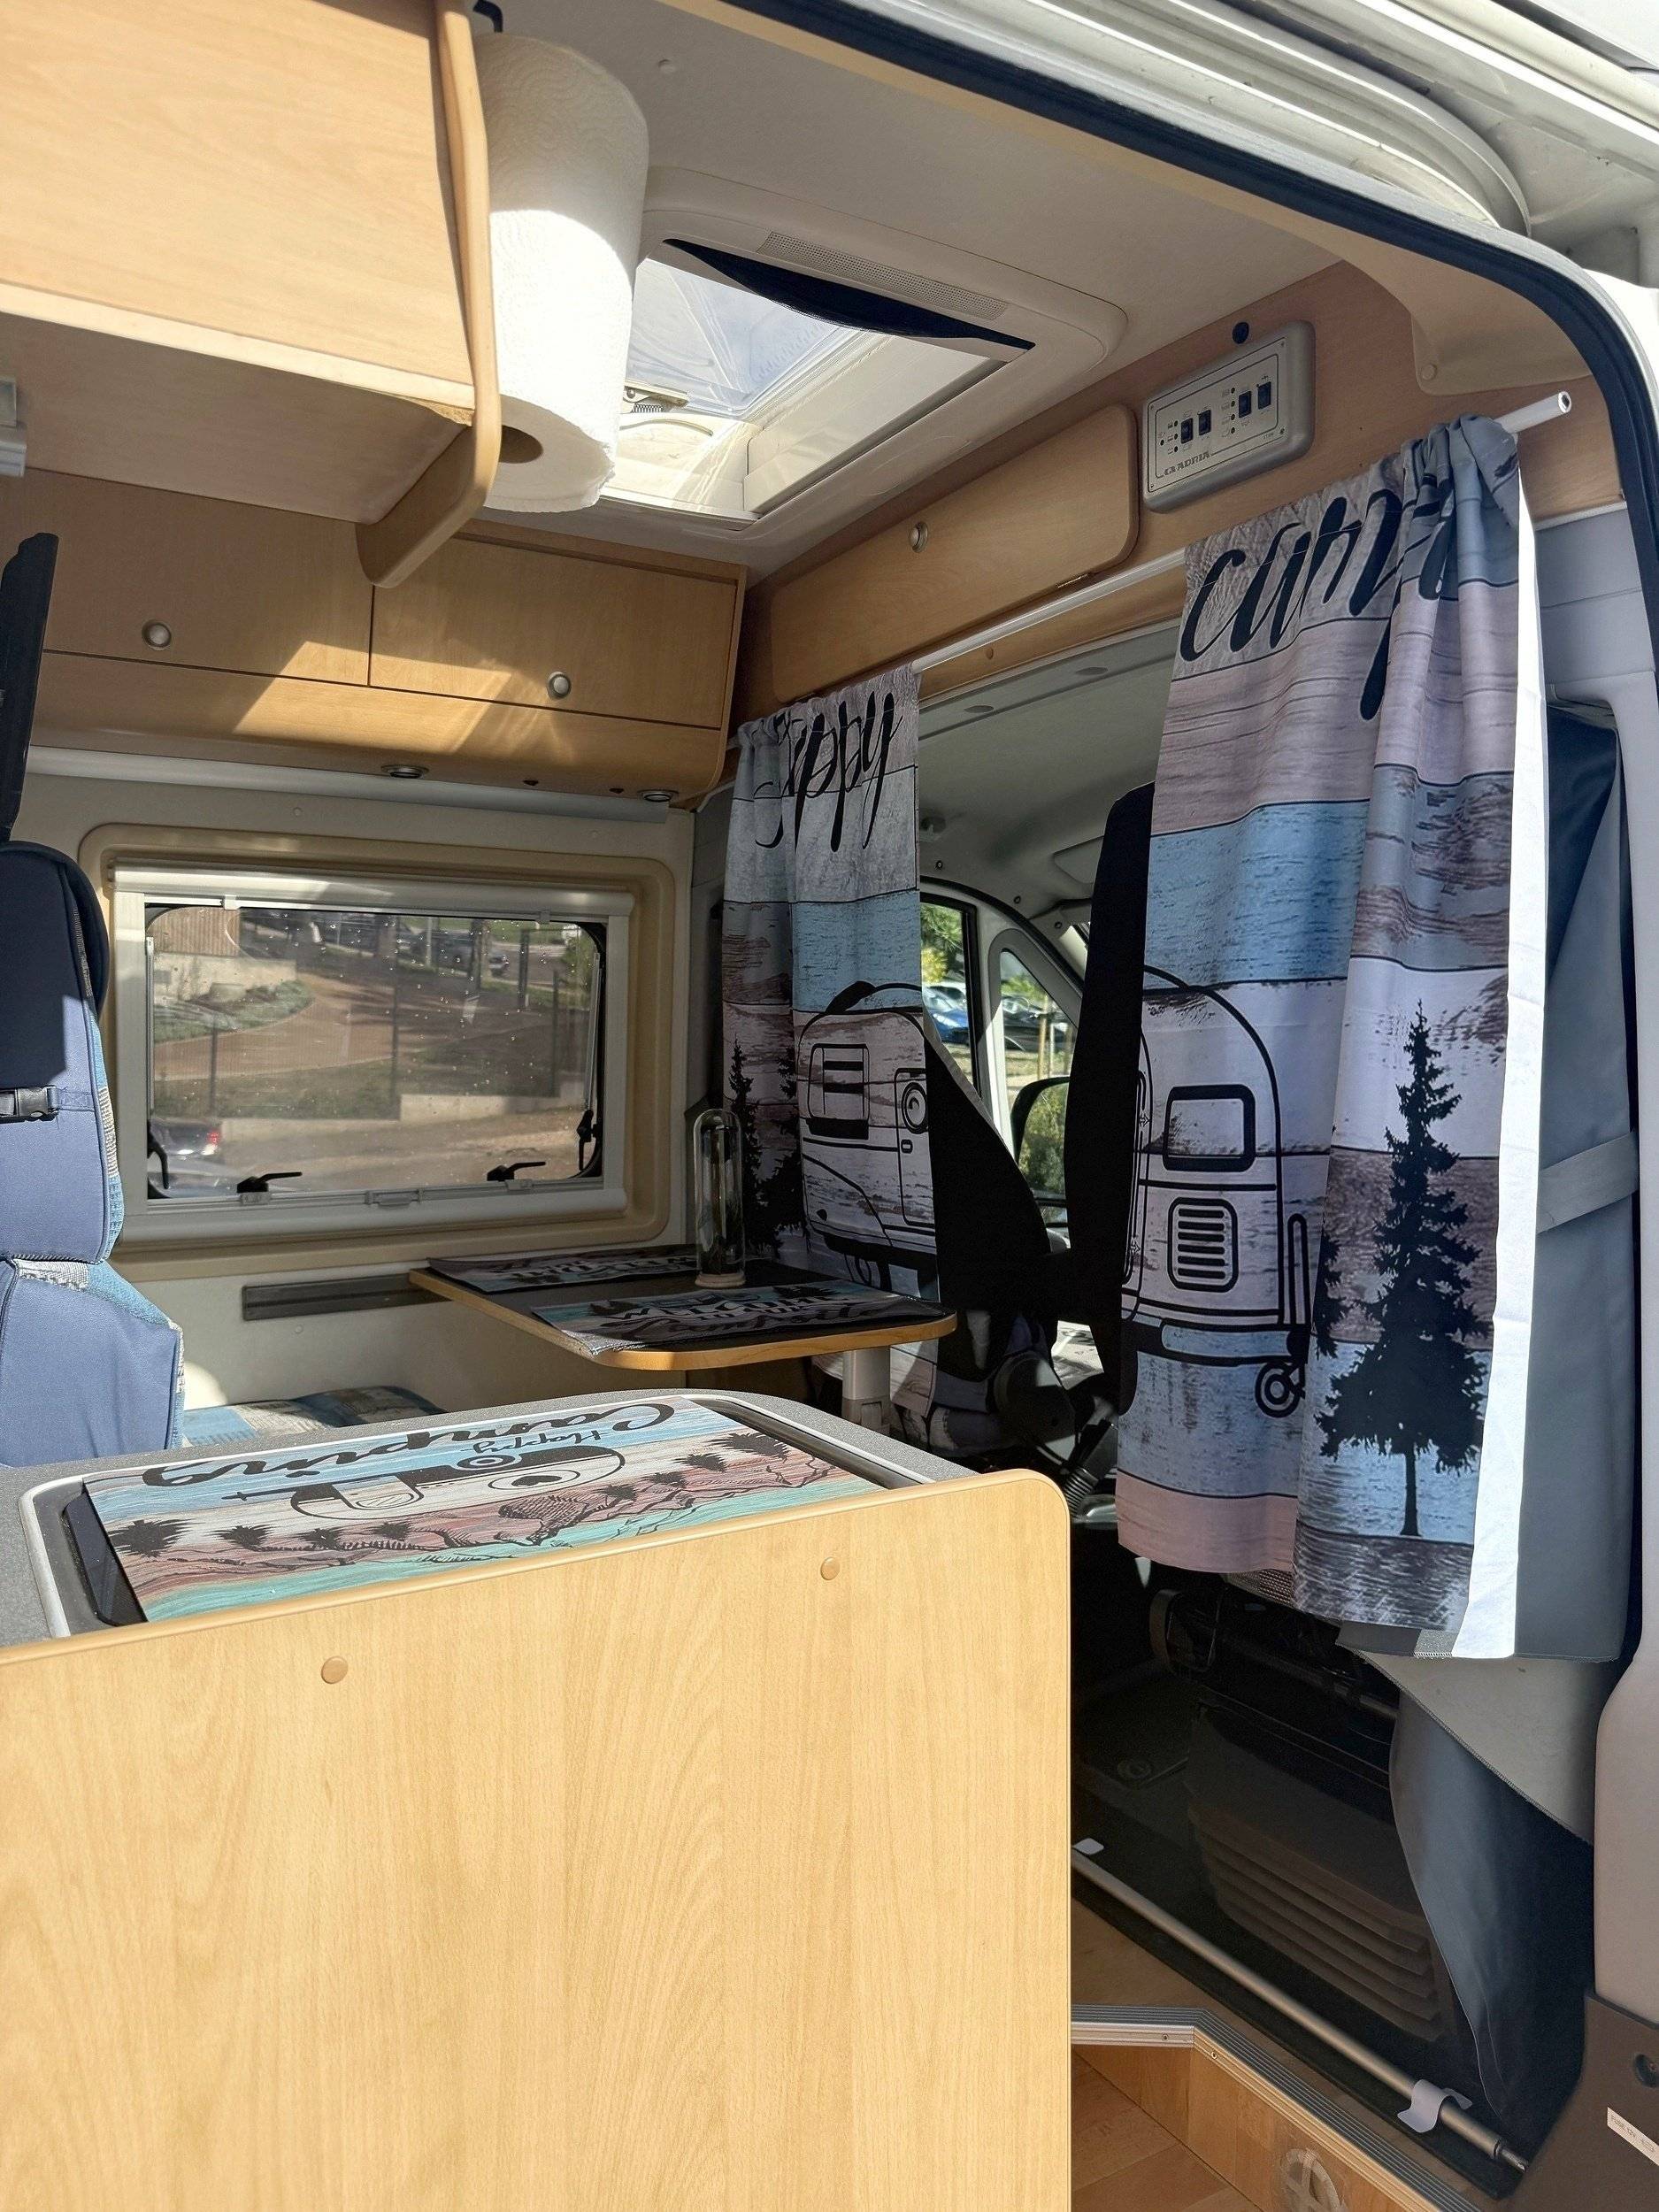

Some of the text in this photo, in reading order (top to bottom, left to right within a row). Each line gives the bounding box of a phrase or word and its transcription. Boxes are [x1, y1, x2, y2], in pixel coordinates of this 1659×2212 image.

[603, 1295, 849, 1321] WELCOME
[142, 1403, 675, 1487] Camping
[461, 1430, 609, 1454] Happy
